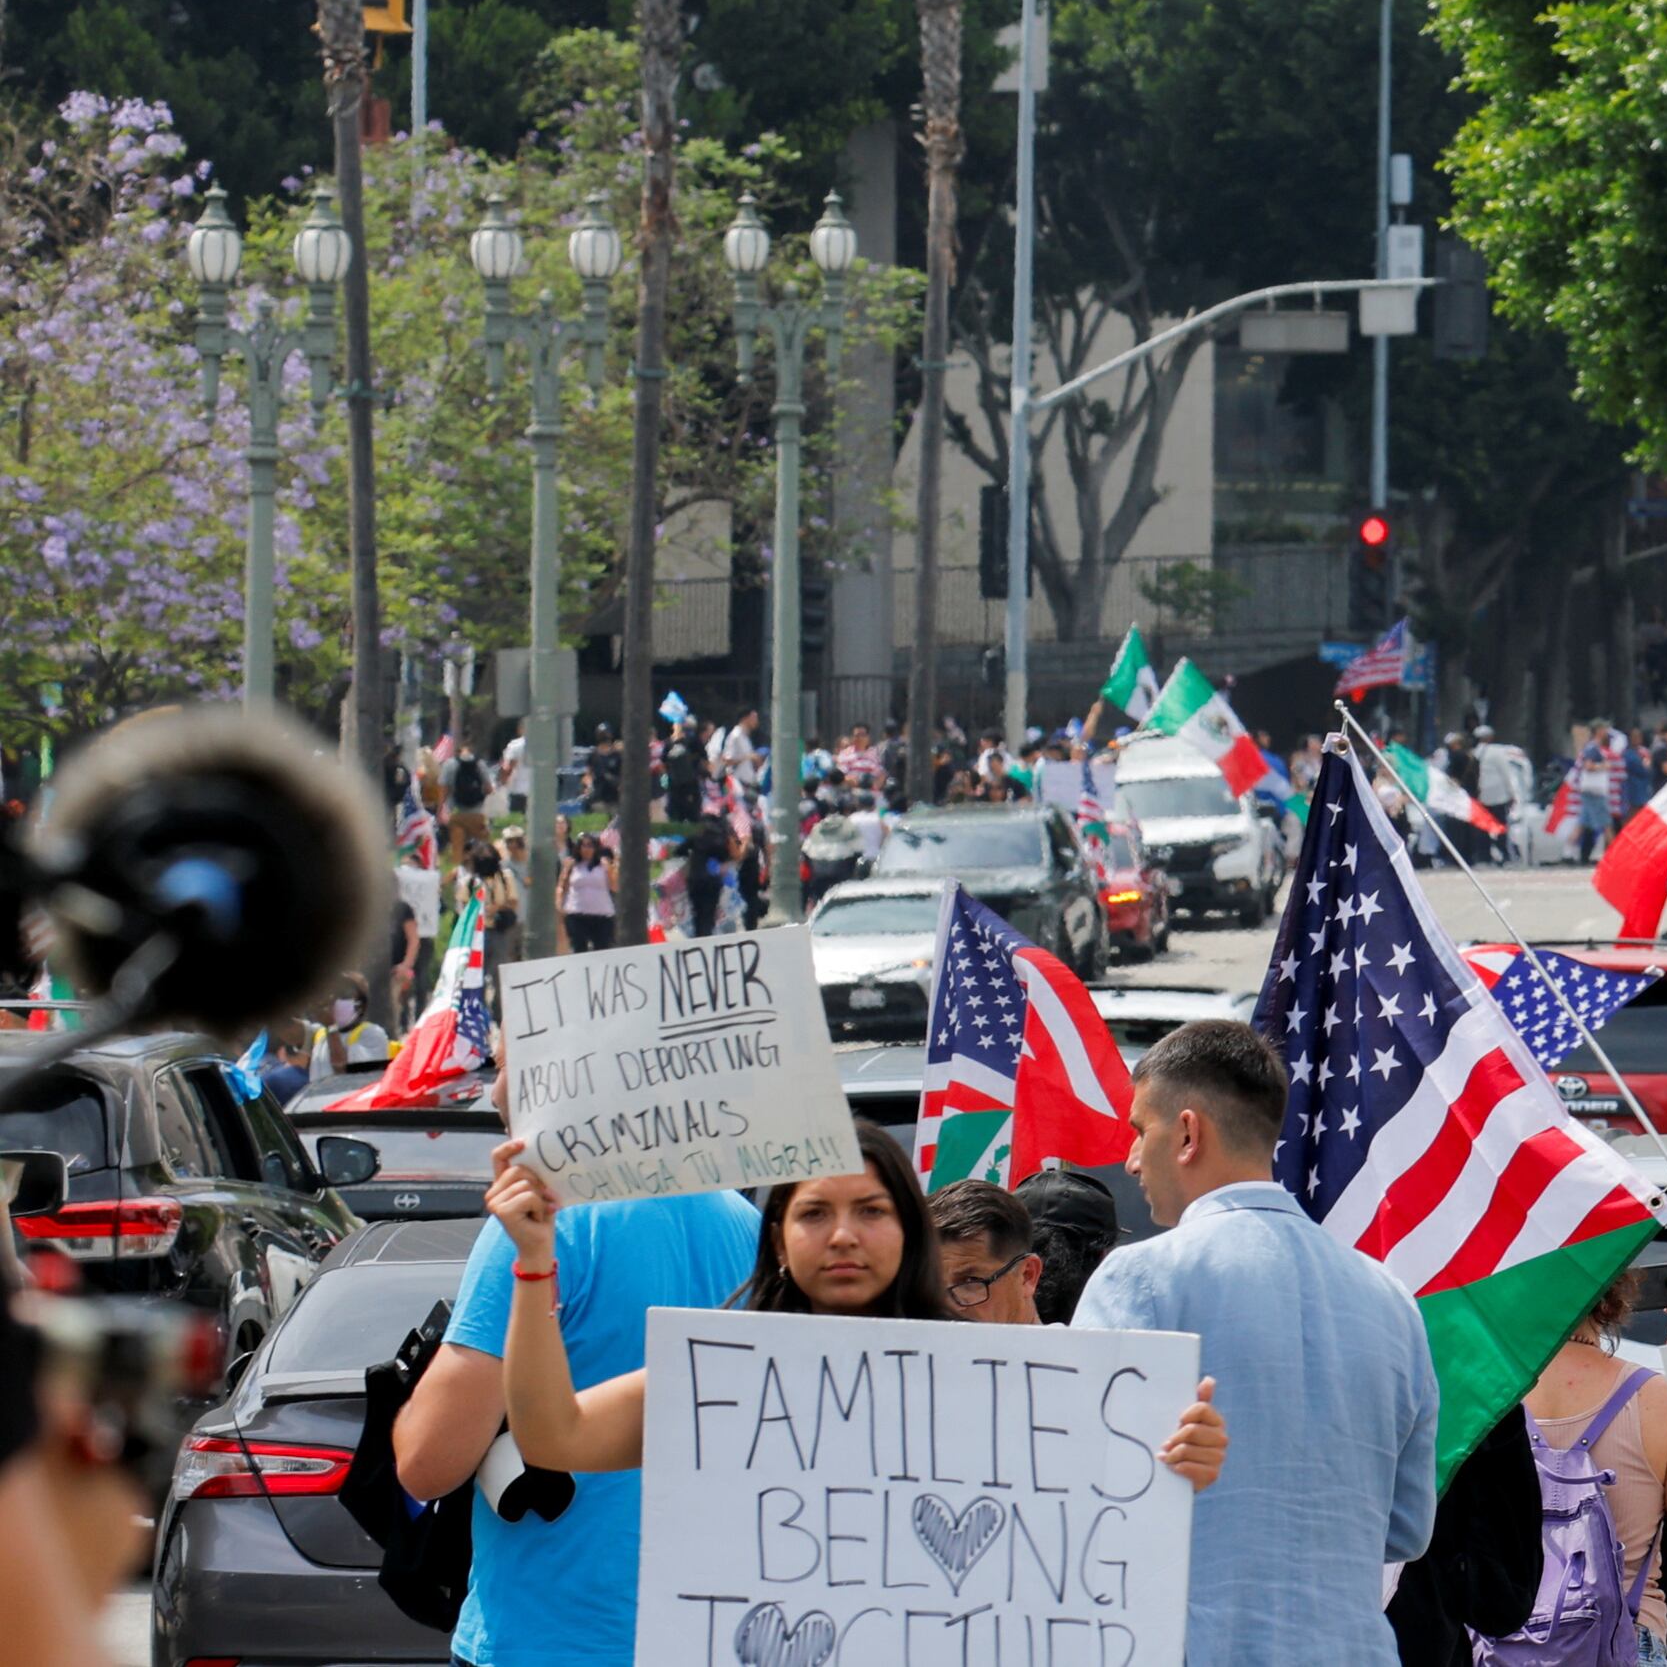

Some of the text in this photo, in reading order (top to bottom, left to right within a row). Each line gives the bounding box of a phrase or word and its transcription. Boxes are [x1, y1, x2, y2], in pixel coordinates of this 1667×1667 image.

[510, 939, 774, 1040] IT WAS NEVER
[517, 1030, 781, 1114] ABOUT DEPORTING
[536, 1099, 750, 1173] CRIMINALS
[568, 1136, 847, 1201] CHINGA TU MIGRA!!
[687, 1337, 1156, 1503] FAMILIES
